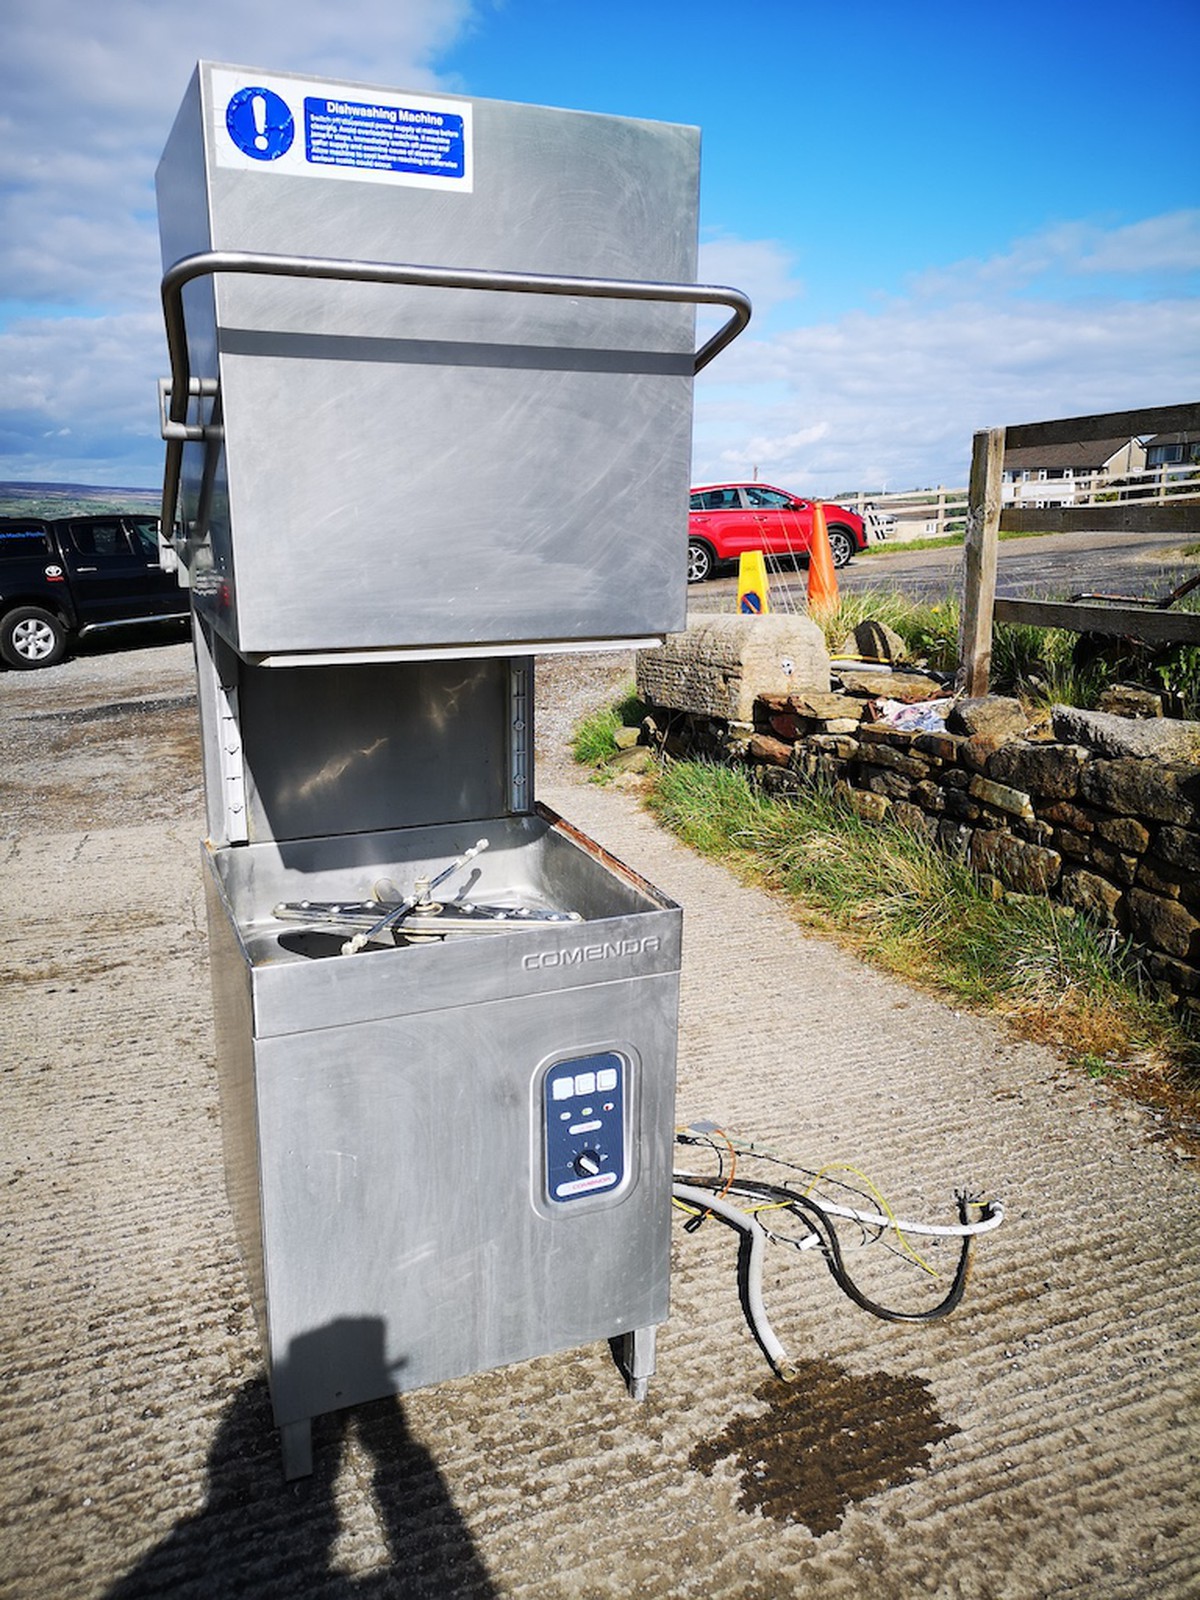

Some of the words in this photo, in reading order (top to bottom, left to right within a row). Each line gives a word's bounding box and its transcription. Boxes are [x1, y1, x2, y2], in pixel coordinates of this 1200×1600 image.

[326, 101, 397, 122] Dishwashing
[398, 109, 444, 126] Machine
[521, 935, 662, 971] COMENDA
